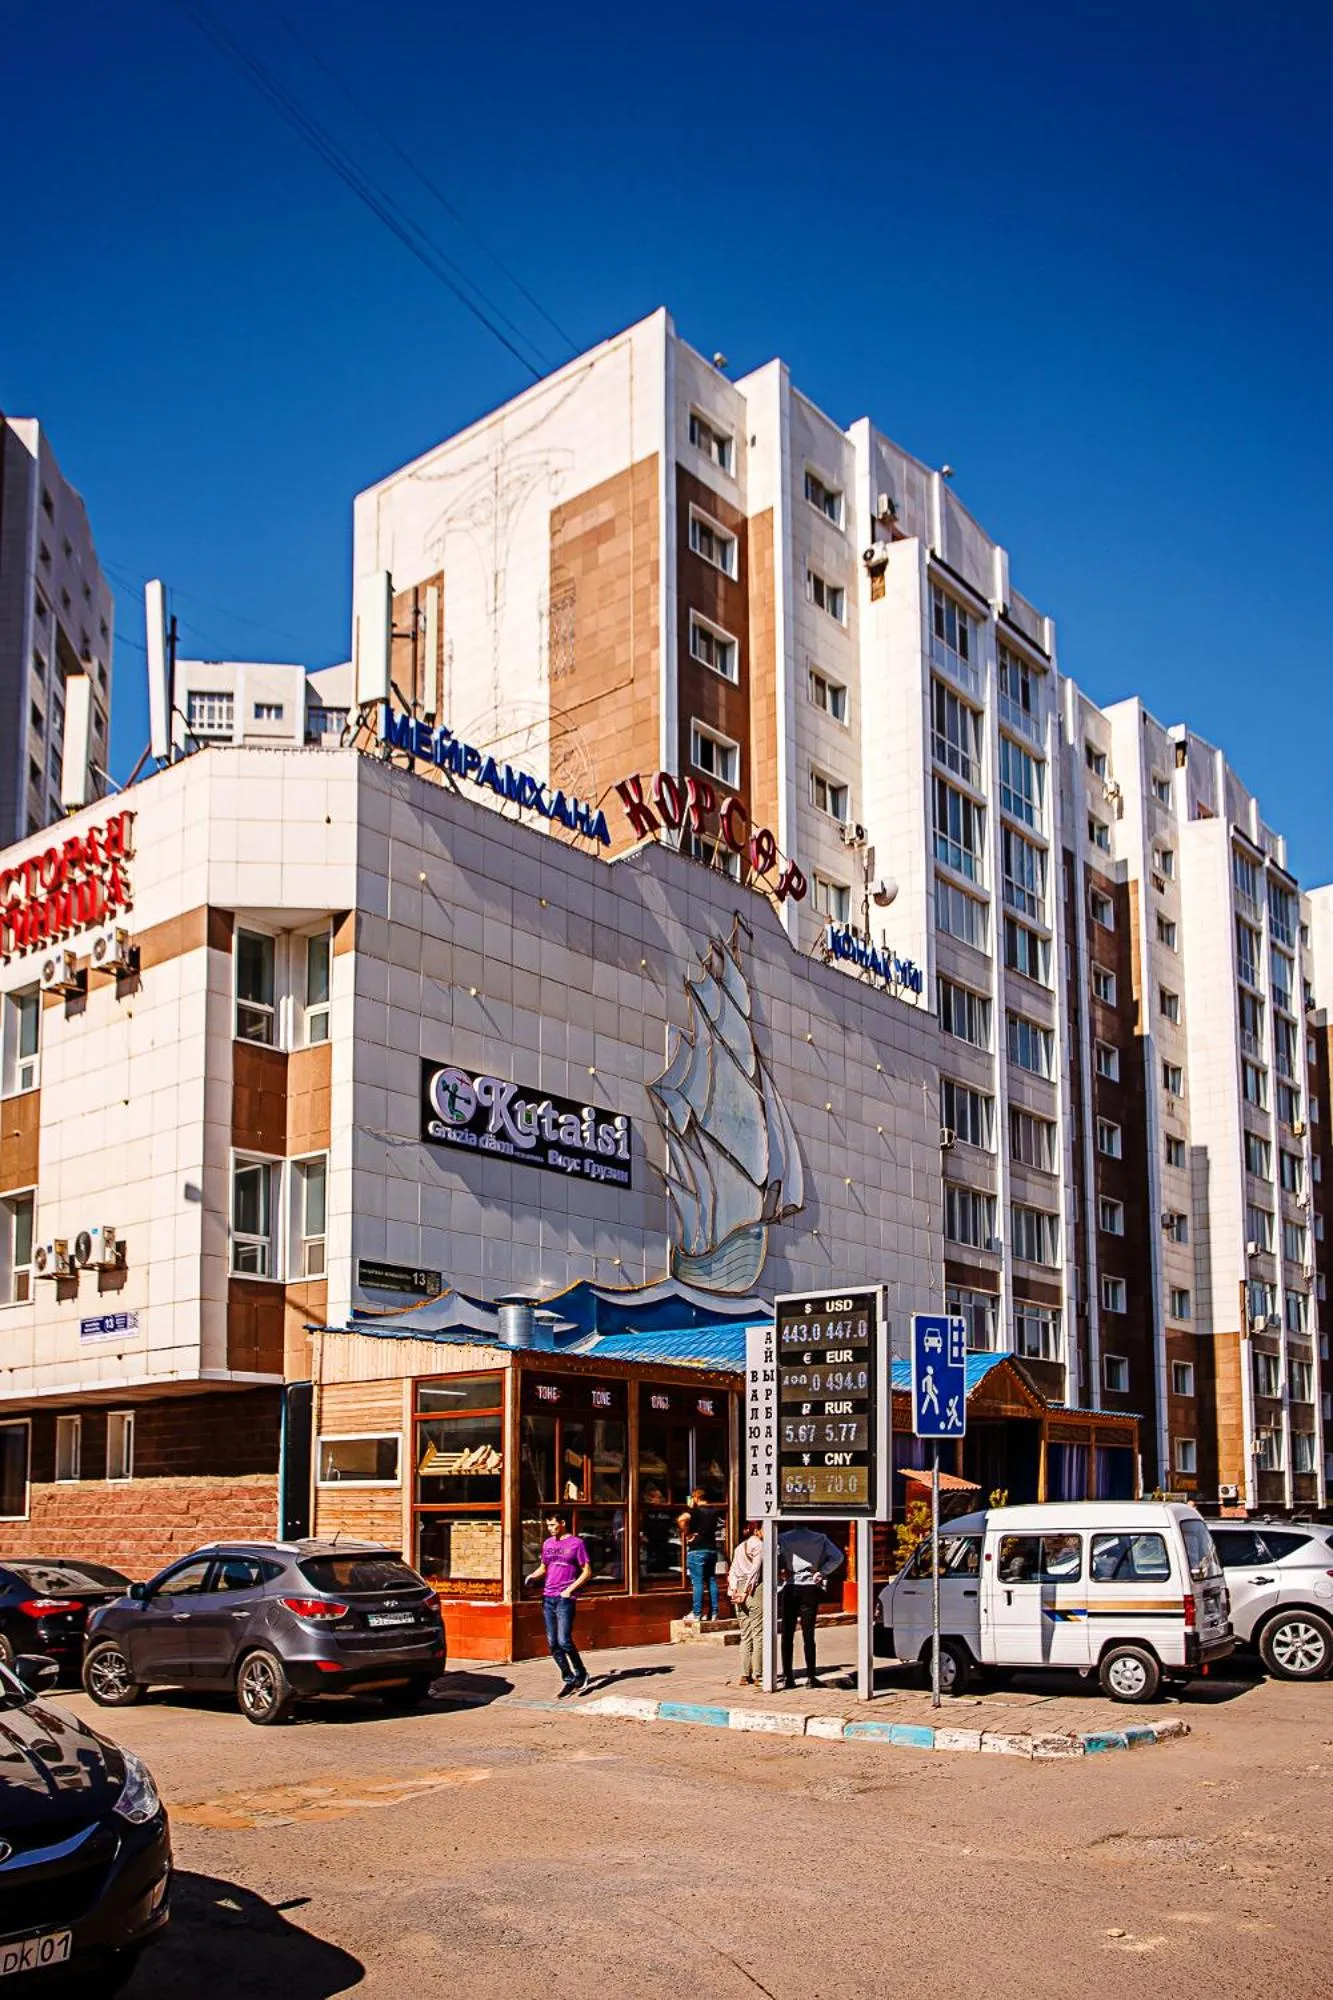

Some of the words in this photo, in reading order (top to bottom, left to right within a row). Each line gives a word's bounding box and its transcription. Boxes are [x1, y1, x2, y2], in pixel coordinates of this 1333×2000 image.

[378, 703, 611, 847] МЕЙРАМХАНА
[473, 1076, 630, 1160] Kutaisi
[428, 1120, 477, 1146] Gruzia
[548, 1149, 581, 1172] Вкус
[584, 1158, 629, 1182] Грузии
[411, 1272, 426, 1287] 13
[826, 1299, 853, 1313] USD
[782, 1322, 821, 1344] 443.0
[826, 1319, 868, 1341] 447.0
[826, 1350, 854, 1364] EUR
[825, 1401, 854, 1415] RUR
[748, 1370, 761, 1477] ВАЛЮТА
[785, 1424, 816, 1443] 5.67
[825, 1422, 857, 1443] 5.77
[825, 1452, 854, 1466] CNY
[41, 1935, 70, 1963] 01
